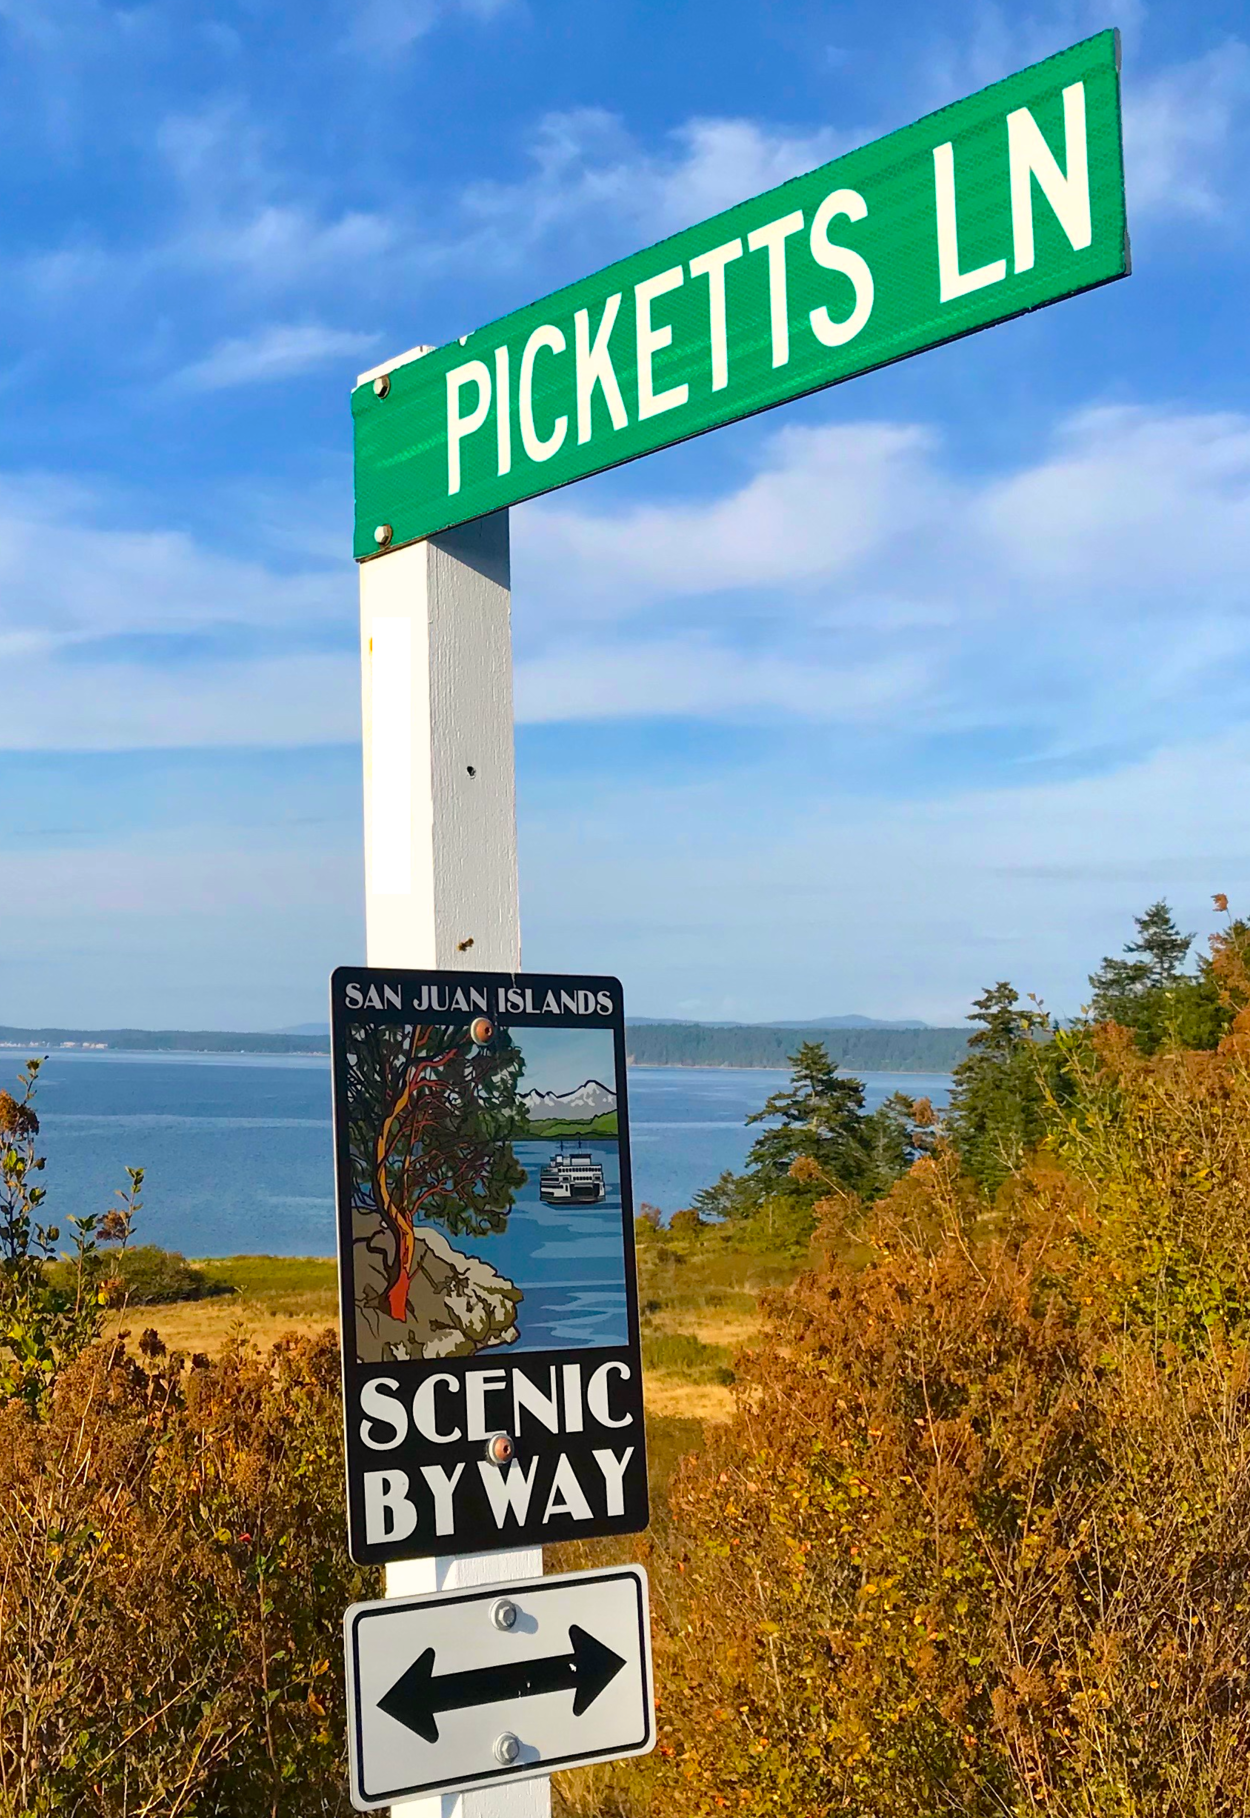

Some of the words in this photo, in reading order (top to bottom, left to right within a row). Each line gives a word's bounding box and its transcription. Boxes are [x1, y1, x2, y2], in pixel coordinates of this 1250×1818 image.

[445, 188, 875, 496] PICKETTS
[932, 80, 1093, 304] LN
[344, 982, 403, 1011] SAN
[412, 985, 488, 1013] JUAN
[497, 987, 614, 1016] ISLANDS
[358, 1360, 635, 1451] SCENIC
[362, 1446, 636, 1546] BYWAY
